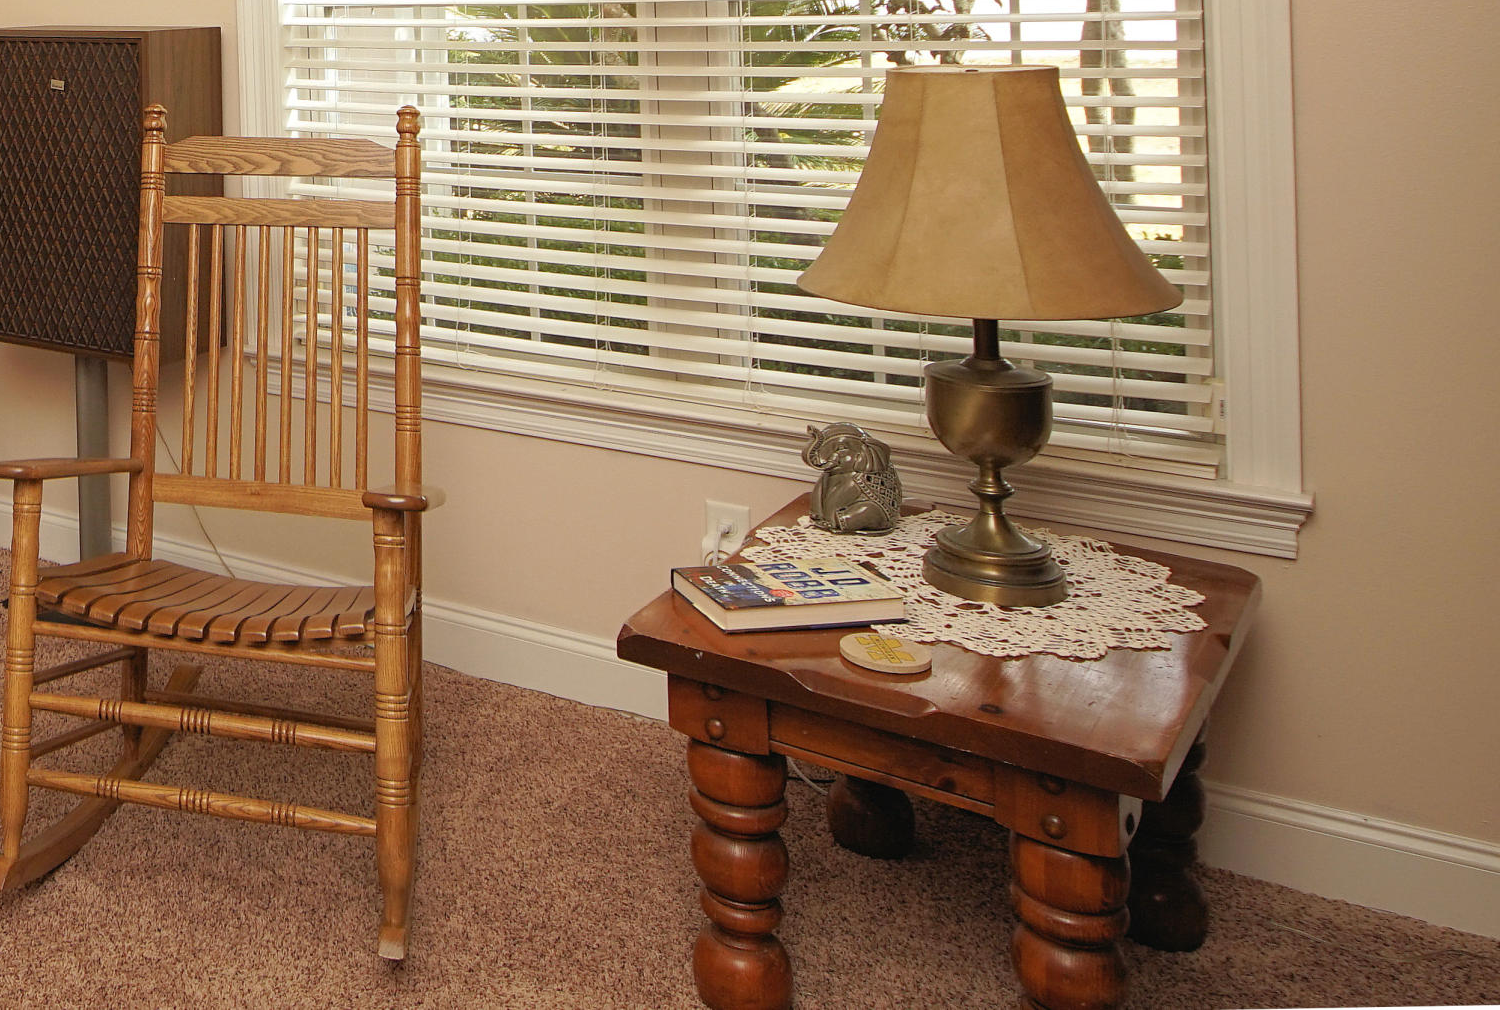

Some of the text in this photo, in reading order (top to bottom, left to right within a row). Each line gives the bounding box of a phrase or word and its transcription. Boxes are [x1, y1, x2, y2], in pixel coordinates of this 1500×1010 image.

[700, 575, 733, 595] DEATH
[716, 565, 777, 603] CONNECTIONS
[755, 562, 841, 599] ROBB
